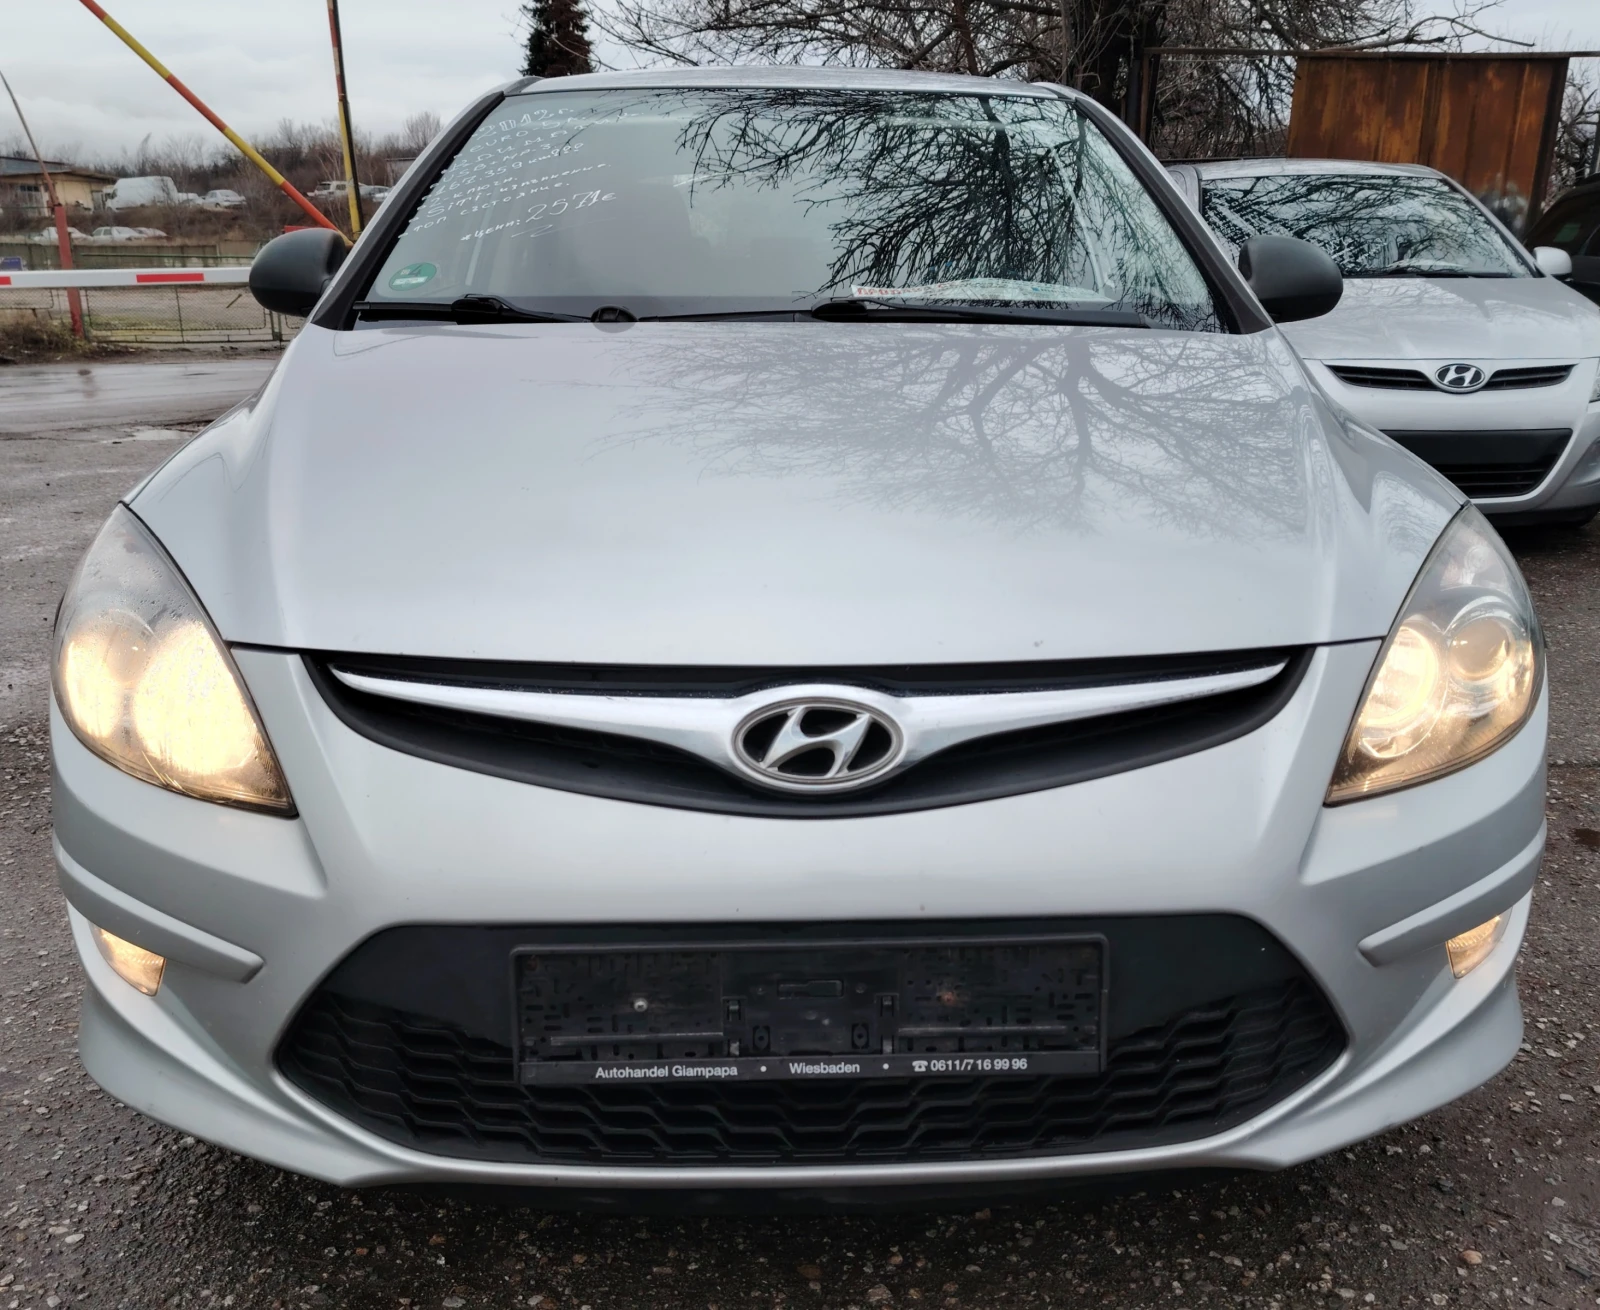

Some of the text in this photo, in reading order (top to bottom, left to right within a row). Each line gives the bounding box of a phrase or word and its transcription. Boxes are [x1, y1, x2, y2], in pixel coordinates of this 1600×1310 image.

[595, 1065, 669, 1079] Autohandel
[671, 1064, 738, 1079] Giampapa
[789, 1061, 861, 1074] Wiesbaden
